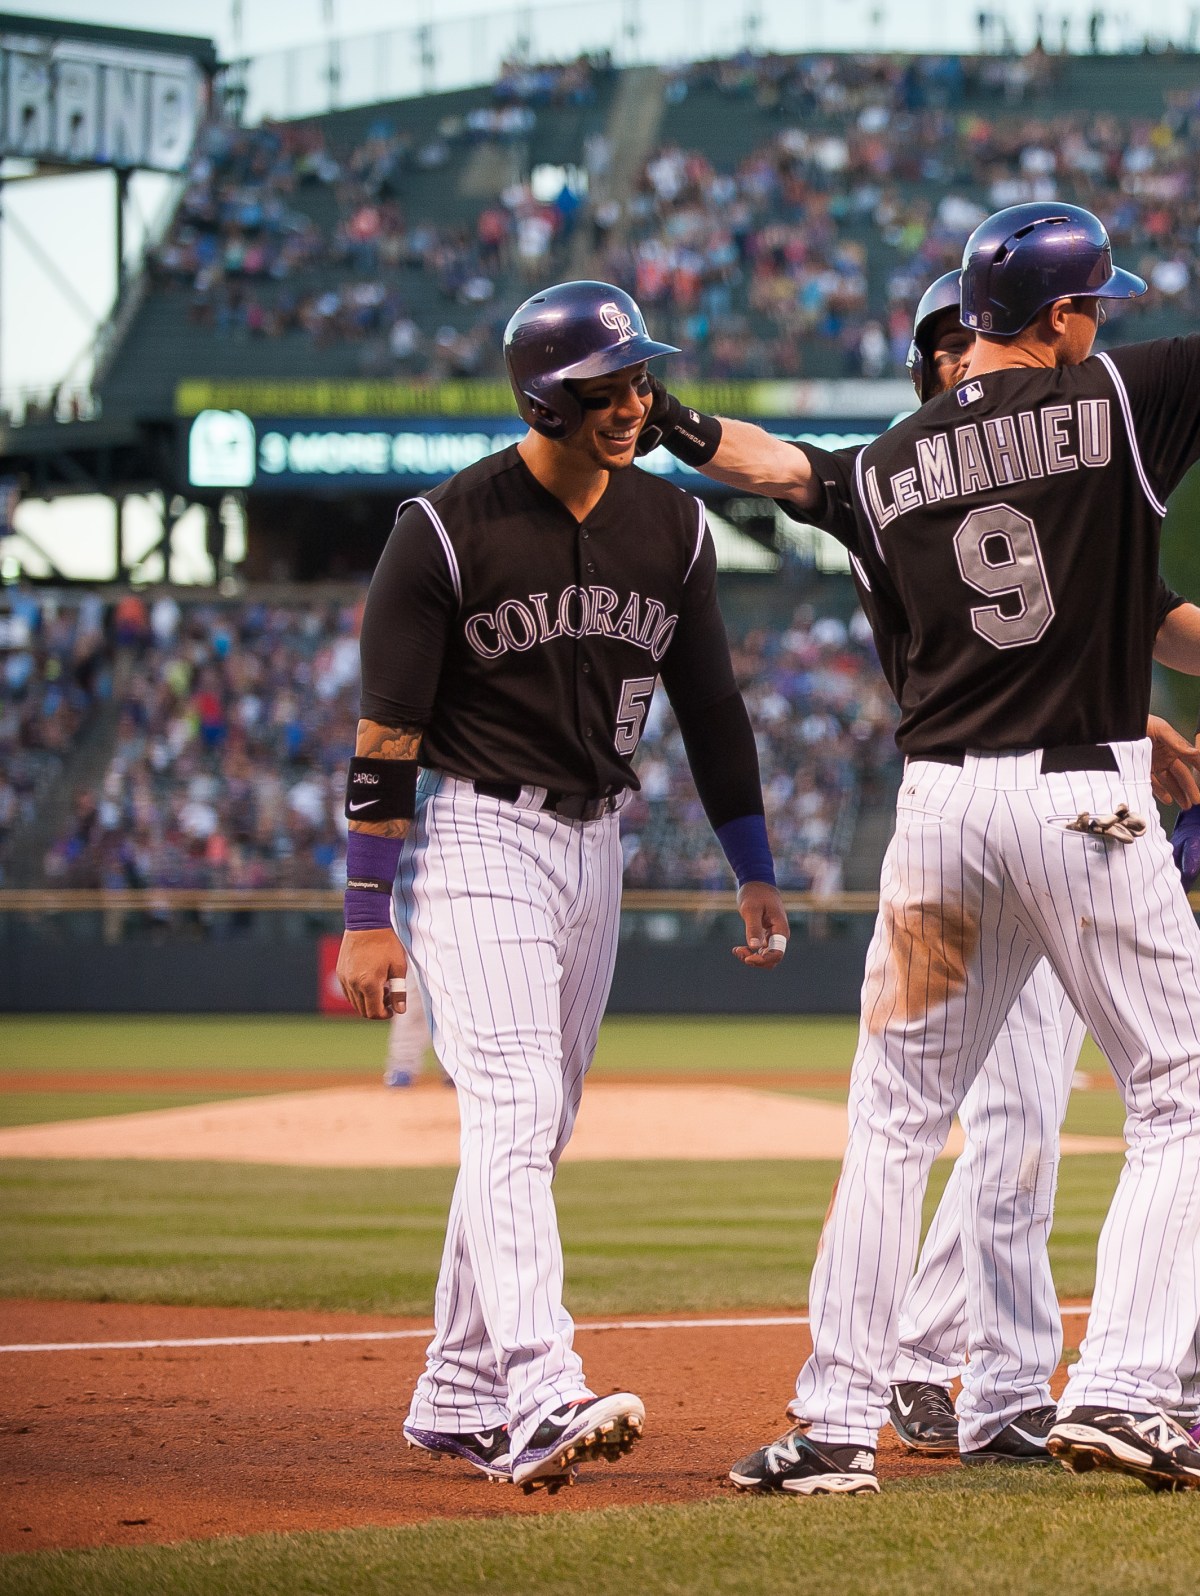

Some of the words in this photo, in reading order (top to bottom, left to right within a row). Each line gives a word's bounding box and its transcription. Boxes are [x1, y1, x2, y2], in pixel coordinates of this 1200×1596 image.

[599, 302, 638, 342] CR
[981, 311, 993, 330] 9
[289, 431, 390, 474] MORE
[952, 502, 1056, 651] 9
[464, 584, 679, 662] COLORADO
[614, 675, 655, 756] 5
